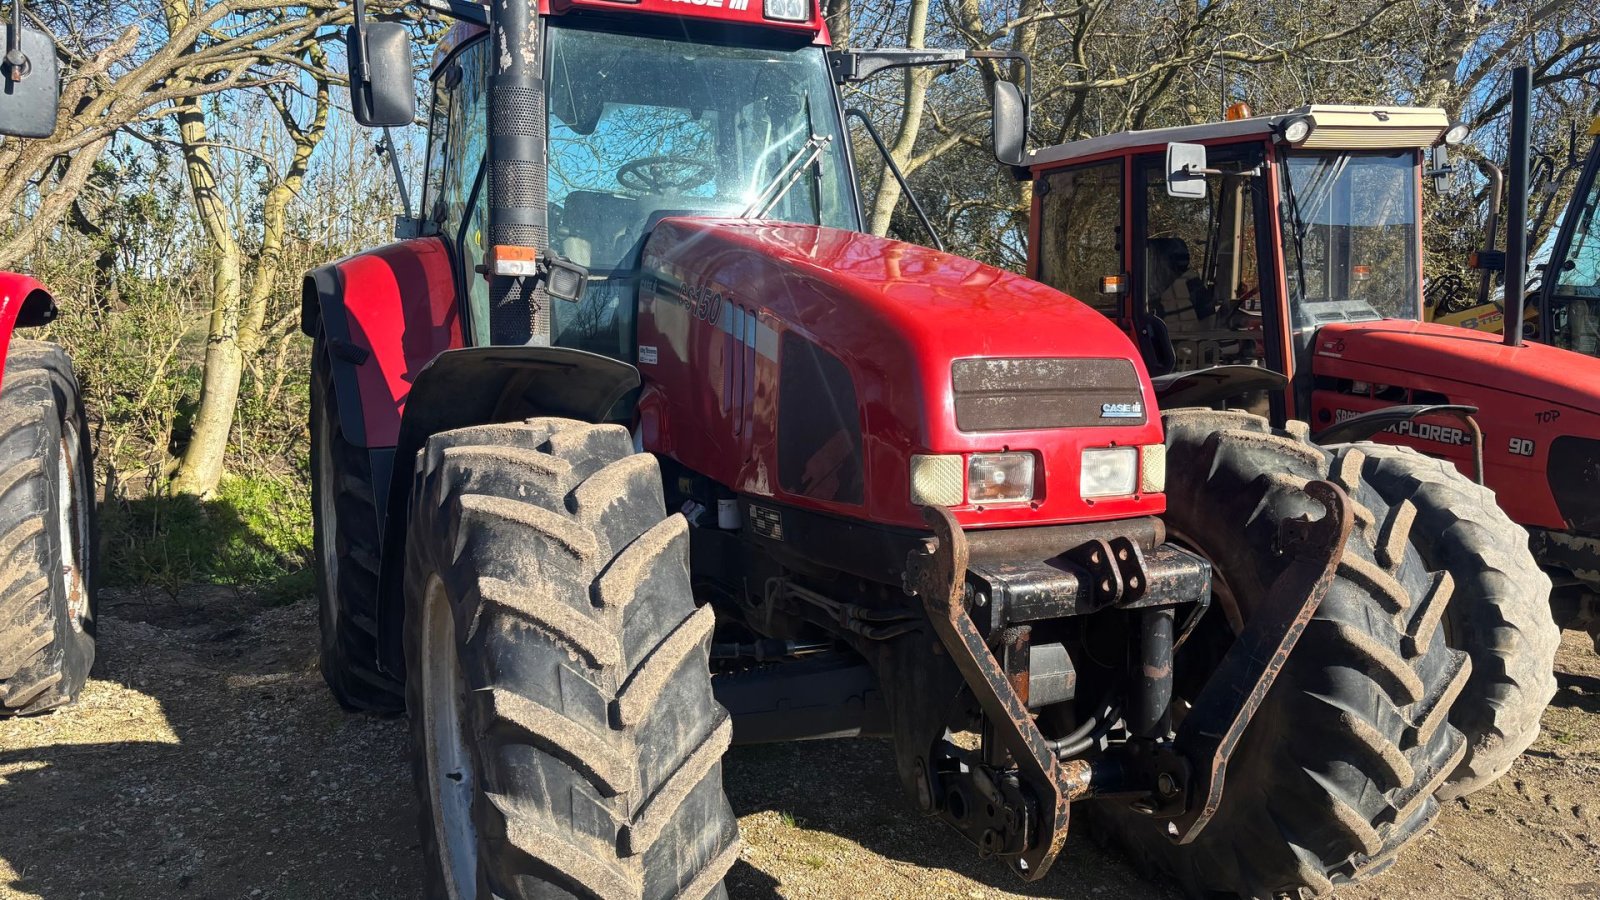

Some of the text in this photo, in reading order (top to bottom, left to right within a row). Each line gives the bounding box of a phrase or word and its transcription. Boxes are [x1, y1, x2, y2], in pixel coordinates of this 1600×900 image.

[1102, 403, 1131, 412] CASE
[1335, 408, 1362, 424] SAM
[1534, 409, 1561, 425] TOP
